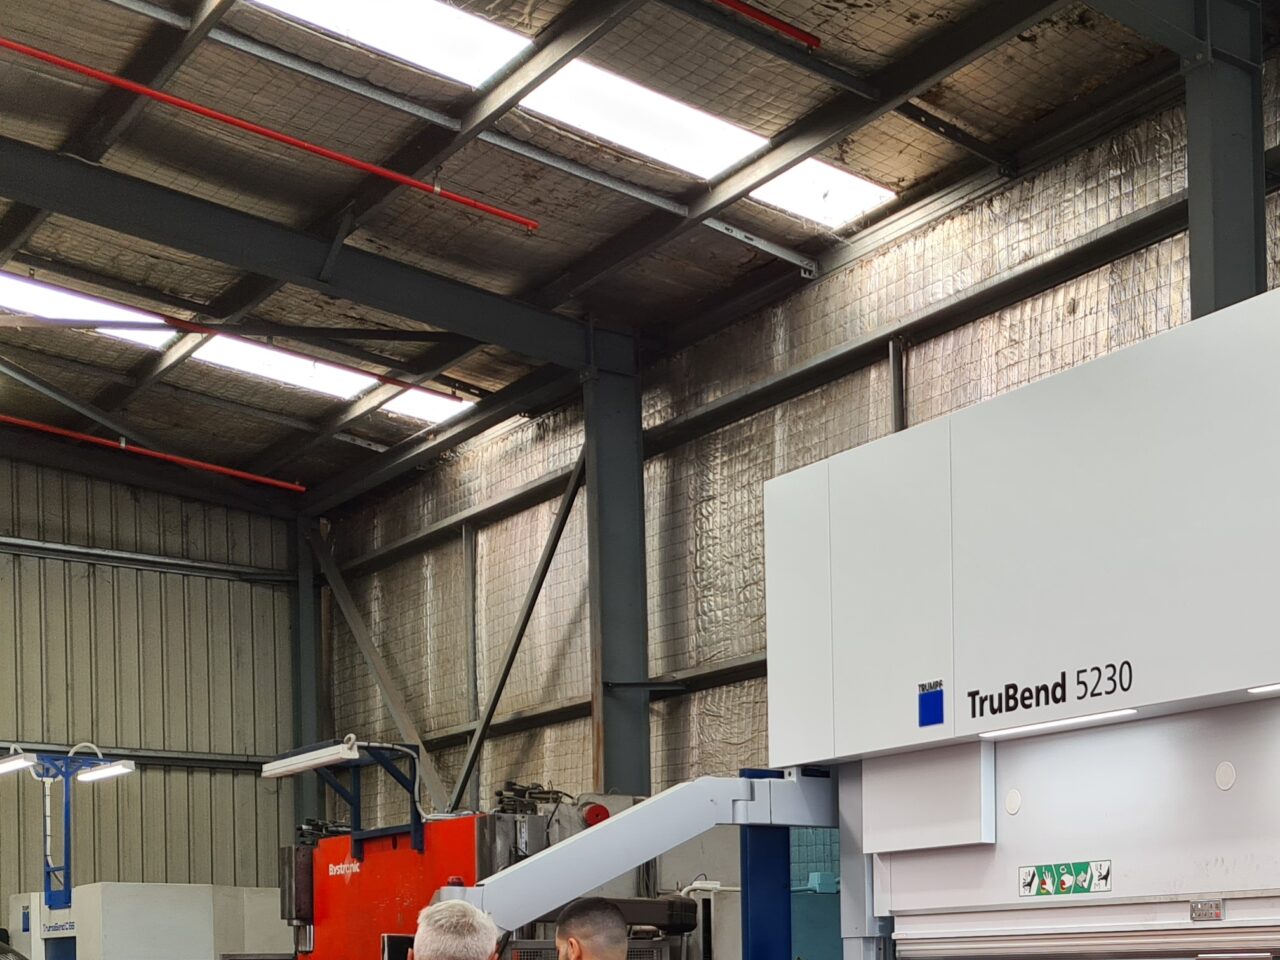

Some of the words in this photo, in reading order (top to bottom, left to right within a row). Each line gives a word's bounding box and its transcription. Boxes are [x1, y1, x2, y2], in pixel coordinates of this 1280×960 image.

[918, 679, 943, 692] TRUMPF
[967, 671, 1067, 719] TruBend
[1076, 660, 1133, 700] 5230
[329, 861, 360, 876] Bystronic
